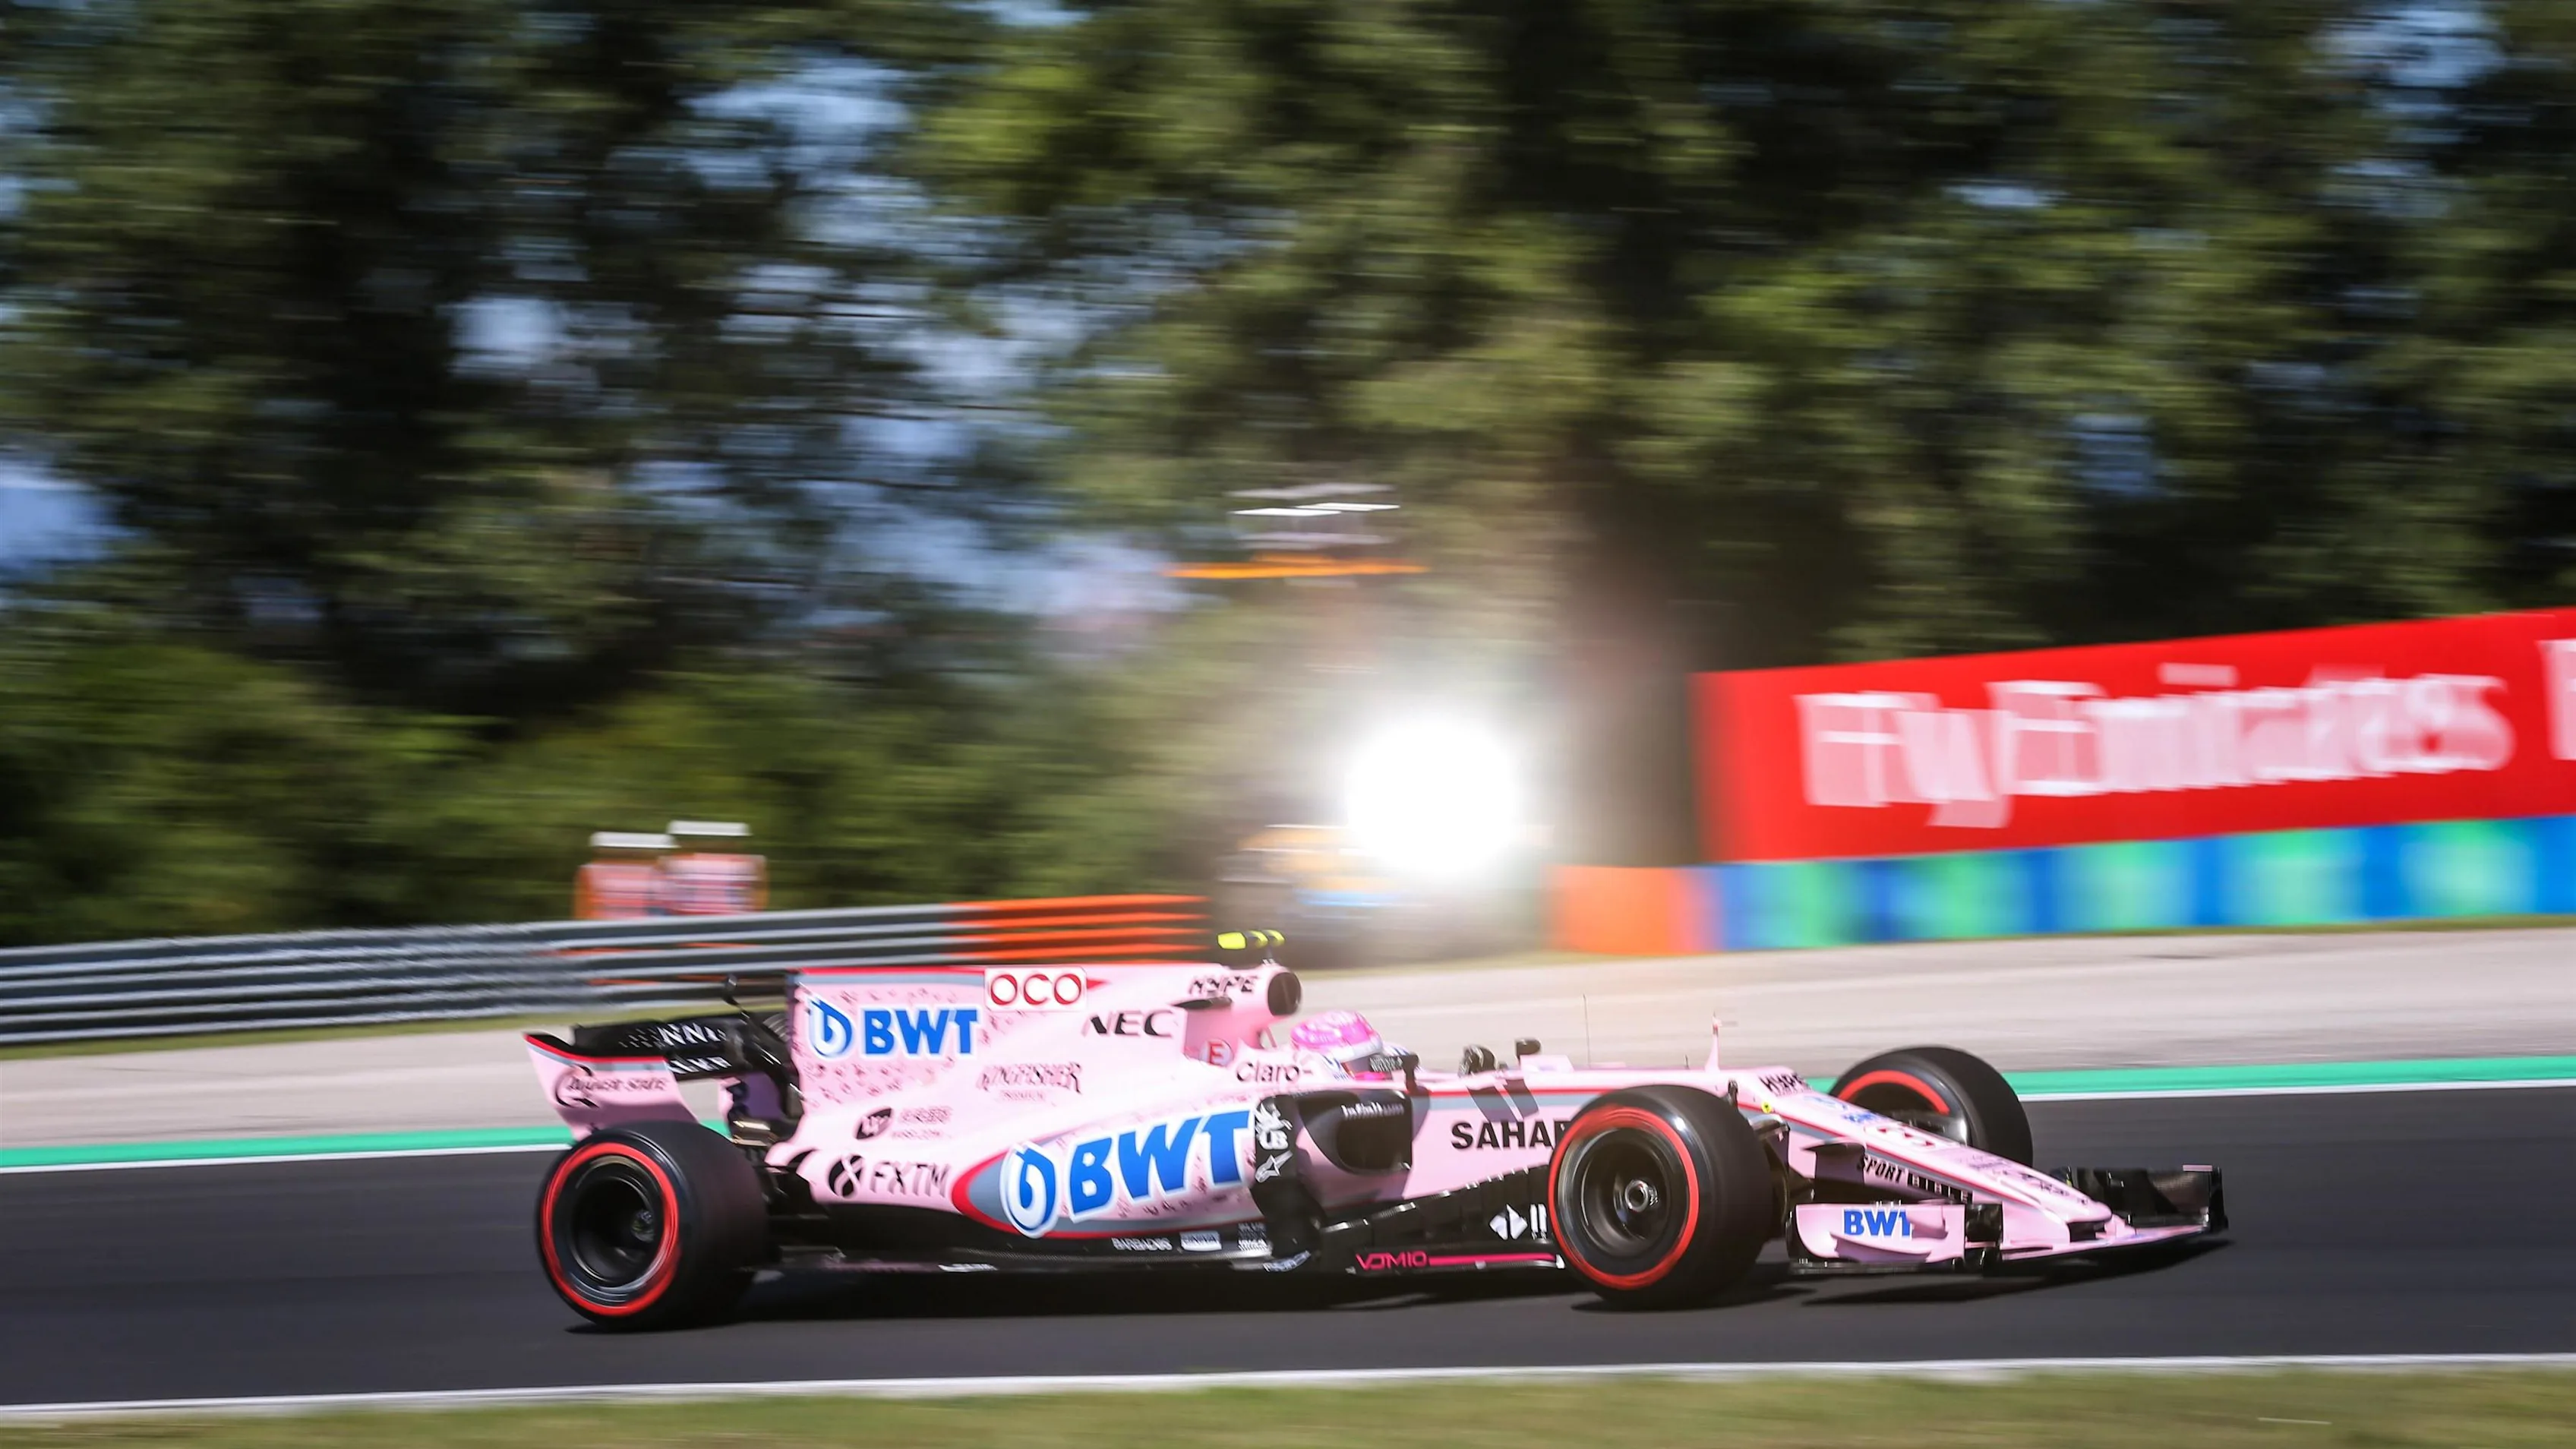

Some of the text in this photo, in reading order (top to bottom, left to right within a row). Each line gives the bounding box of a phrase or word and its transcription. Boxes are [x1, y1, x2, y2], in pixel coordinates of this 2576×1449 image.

[1794, 690, 2009, 828] Fly
[1985, 662, 2515, 799] Emirates
[990, 974, 1081, 1005] OCO
[864, 1009, 977, 1054] BWT
[1081, 1009, 1175, 1037] NEC
[870, 1161, 950, 1198] FXTM
[1070, 1110, 1250, 1214] BWT
